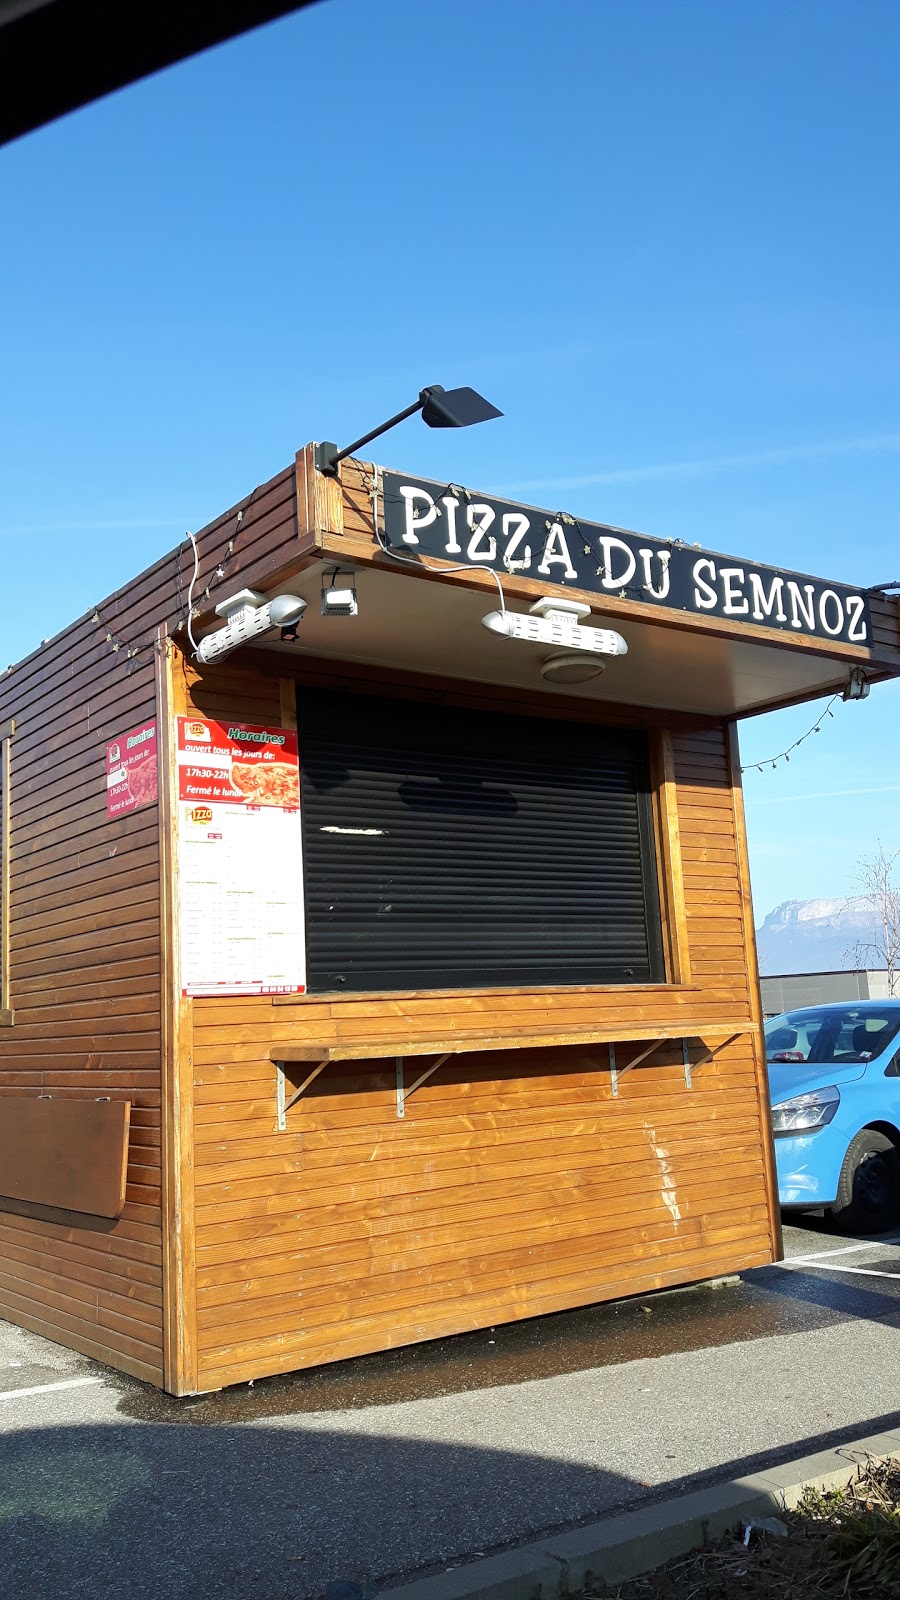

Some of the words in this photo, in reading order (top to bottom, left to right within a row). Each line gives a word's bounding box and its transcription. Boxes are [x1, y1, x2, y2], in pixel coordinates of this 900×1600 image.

[399, 486, 578, 579] PIZZA
[599, 536, 671, 599] DU
[693, 559, 867, 641] SEMNOZ
[127, 727, 155, 749] Horaires
[227, 728, 285, 744] Horaires
[185, 745, 211, 754] ouvert
[213, 746, 231, 756] tous
[231, 747, 242, 757] les
[243, 749, 262, 760] jours
[264, 751, 276, 760] de:
[186, 768, 229, 780] 17h30-22h
[186, 785, 212, 795] Fermé
[213, 786, 221, 796] le
